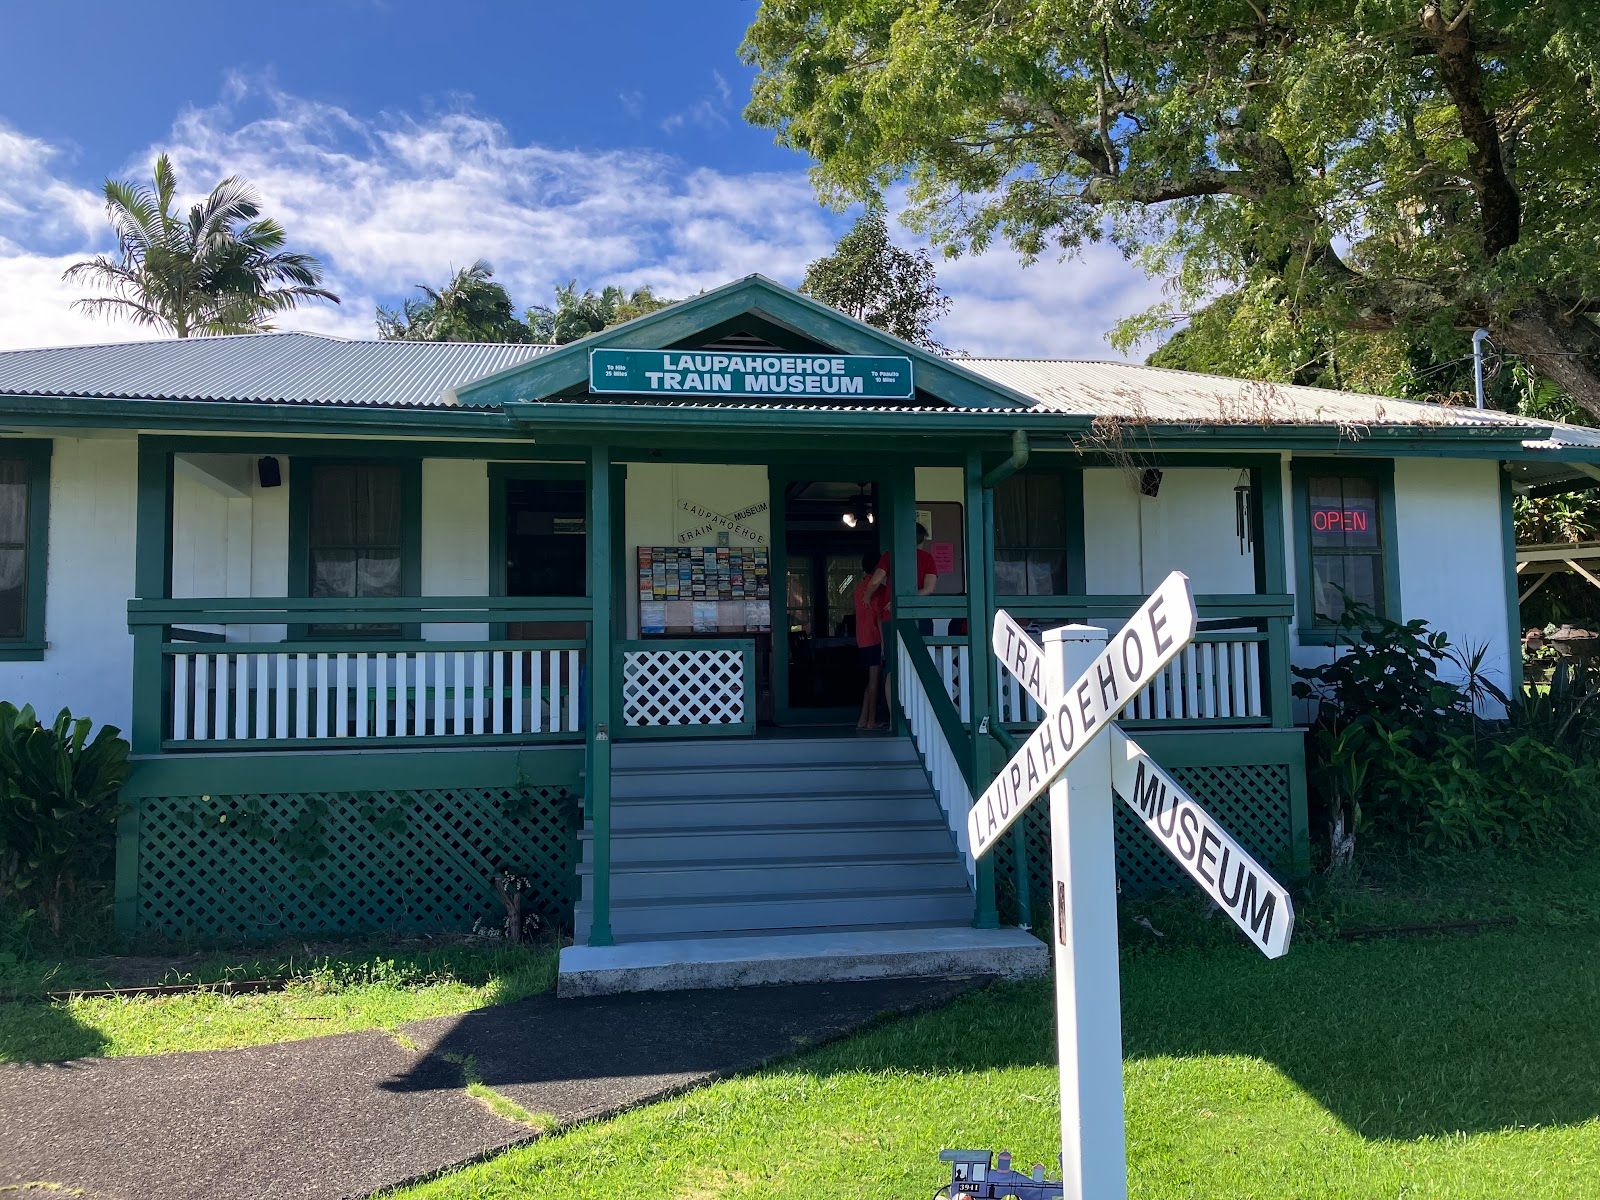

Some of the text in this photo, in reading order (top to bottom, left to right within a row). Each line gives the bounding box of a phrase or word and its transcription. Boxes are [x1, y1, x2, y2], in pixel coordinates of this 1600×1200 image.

[645, 372, 864, 393] TRAIN MUSEUM
[663, 355, 845, 375] LAUPAHOEHOE
[680, 502, 768, 542] TRAIN MUSEUM
[683, 502, 765, 544] LAUPAHOEHOE
[1314, 511, 1366, 530] OPEN
[974, 594, 1173, 848] LAUPAHOEHOE
[1005, 623, 1277, 946] TRA MUSEUM
